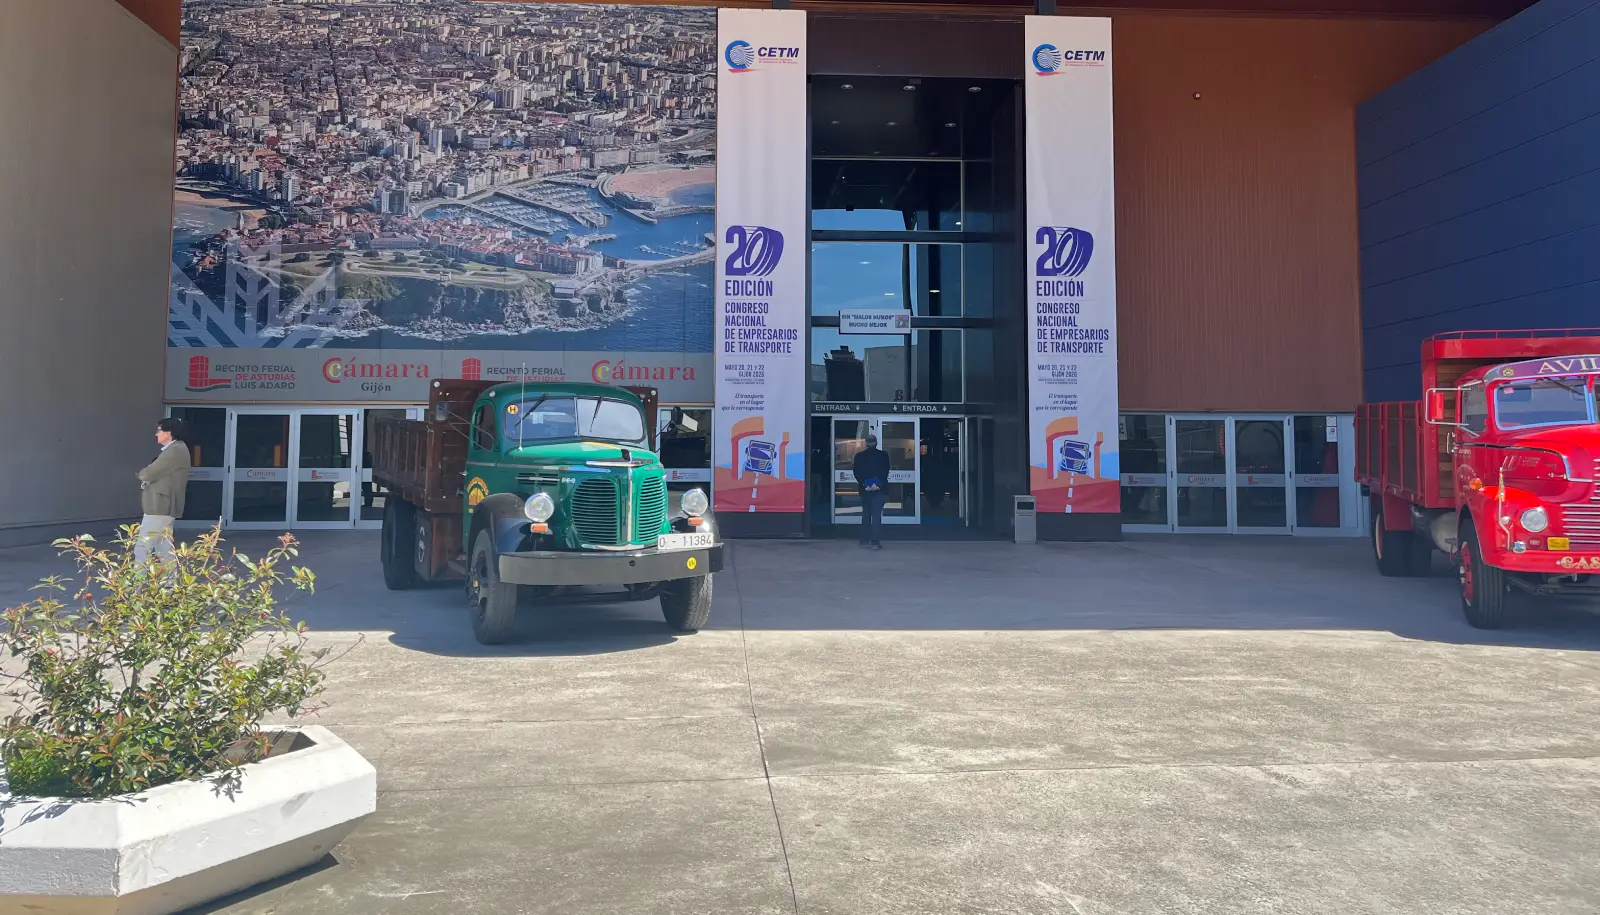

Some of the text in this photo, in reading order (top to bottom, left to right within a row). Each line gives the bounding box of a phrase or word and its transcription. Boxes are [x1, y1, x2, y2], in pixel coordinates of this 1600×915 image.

[758, 46, 799, 58] CETM
[1064, 50, 1105, 61] CETM
[725, 226, 784, 276] 20
[1036, 226, 1093, 277] 20
[725, 278, 773, 296] EDICIÓN
[1036, 278, 1084, 296] EDICIÓN
[725, 302, 769, 314] CONGRESO
[1037, 302, 1080, 314] CONGRESO
[725, 315, 766, 327] NACIONAL
[1037, 316, 1078, 327] NACIONAL
[725, 329, 798, 340] DE EMPRESARIOS
[1038, 329, 1109, 340] DE EMPRESARIOS
[725, 341, 792, 353] DE TRANSPORTE
[1038, 342, 1103, 353] DE TRANSPORTE
[215, 364, 259, 372] RECINTO
[322, 357, 429, 384] Cámara
[592, 360, 695, 384] Cámara
[361, 382, 392, 393] Gijón
[683, 535, 711, 546] 11384
